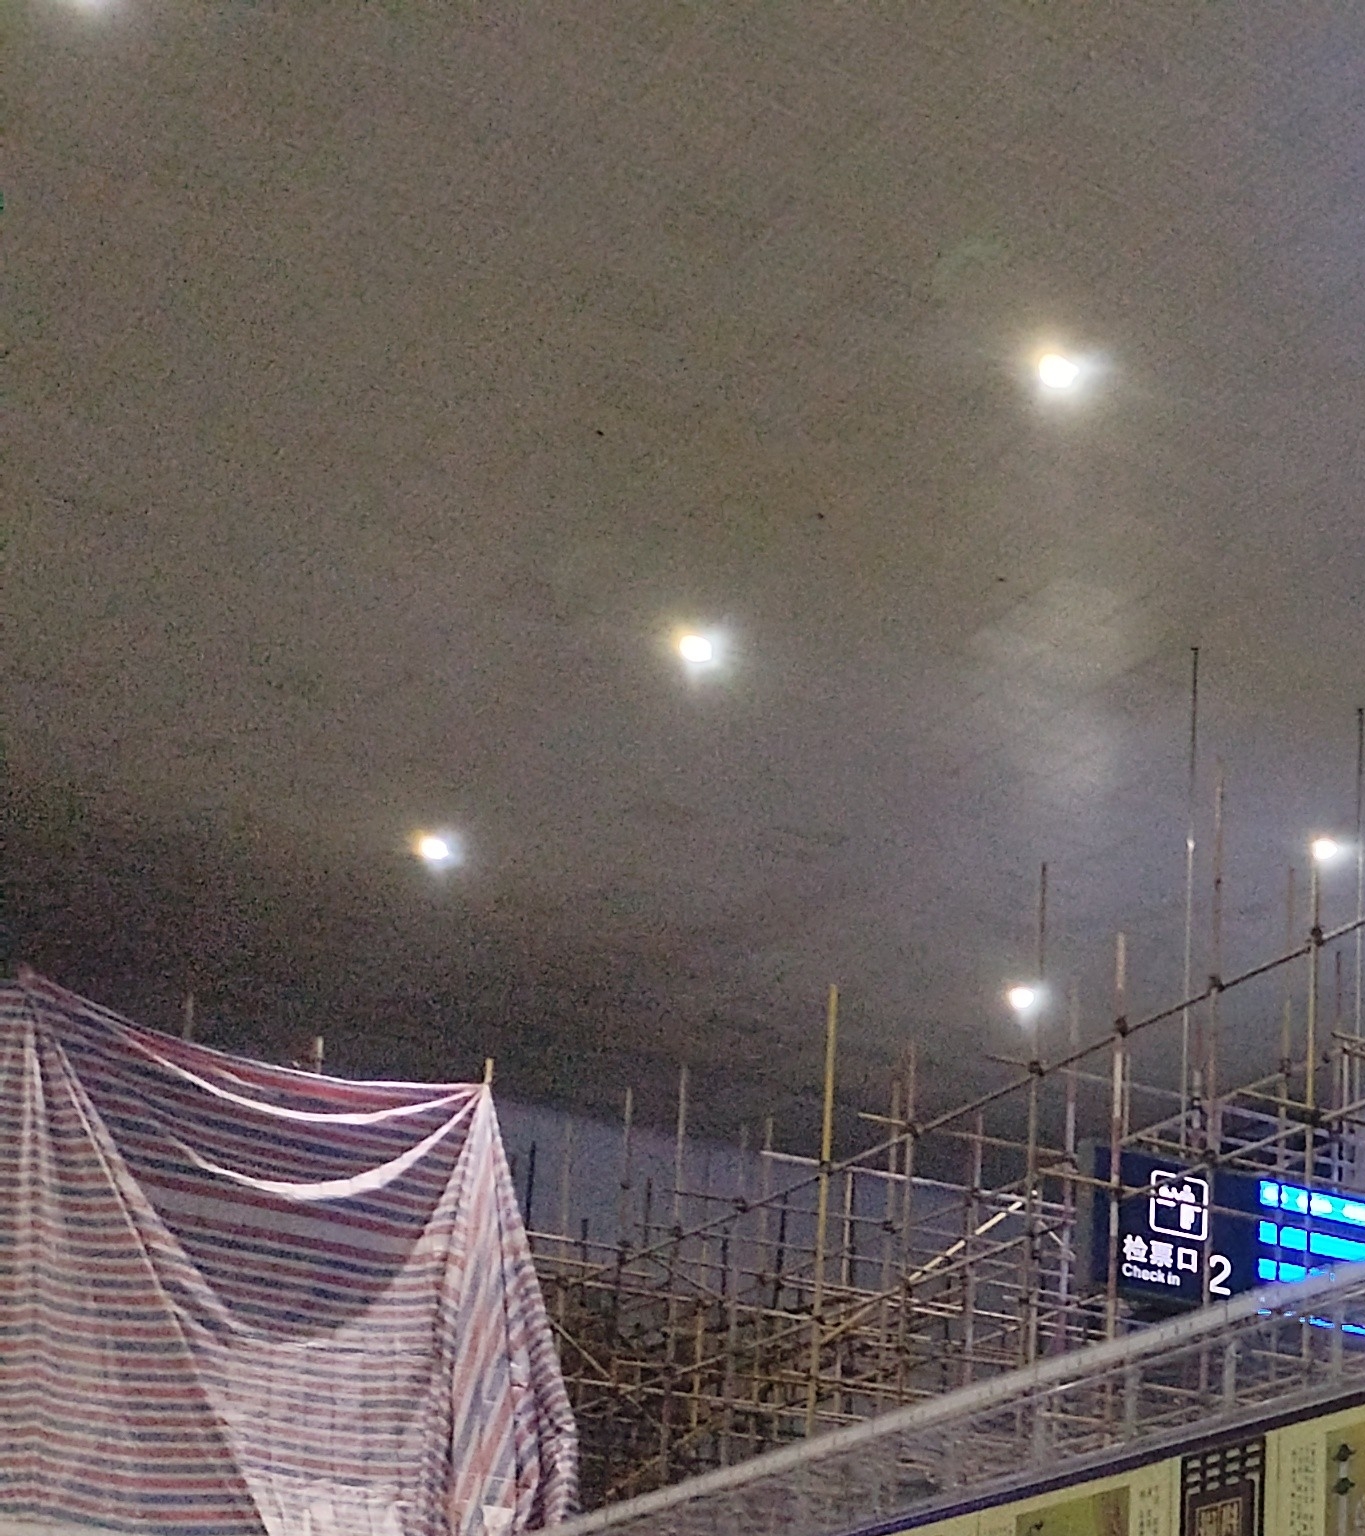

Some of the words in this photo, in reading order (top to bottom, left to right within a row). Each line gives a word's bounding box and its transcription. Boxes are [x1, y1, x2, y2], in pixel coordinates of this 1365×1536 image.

[1121, 1263, 1166, 1284] Check
[1167, 1271, 1181, 1287] in
[1122, 1234, 1198, 1273] 检票口
[1209, 1255, 1232, 1296] 2
